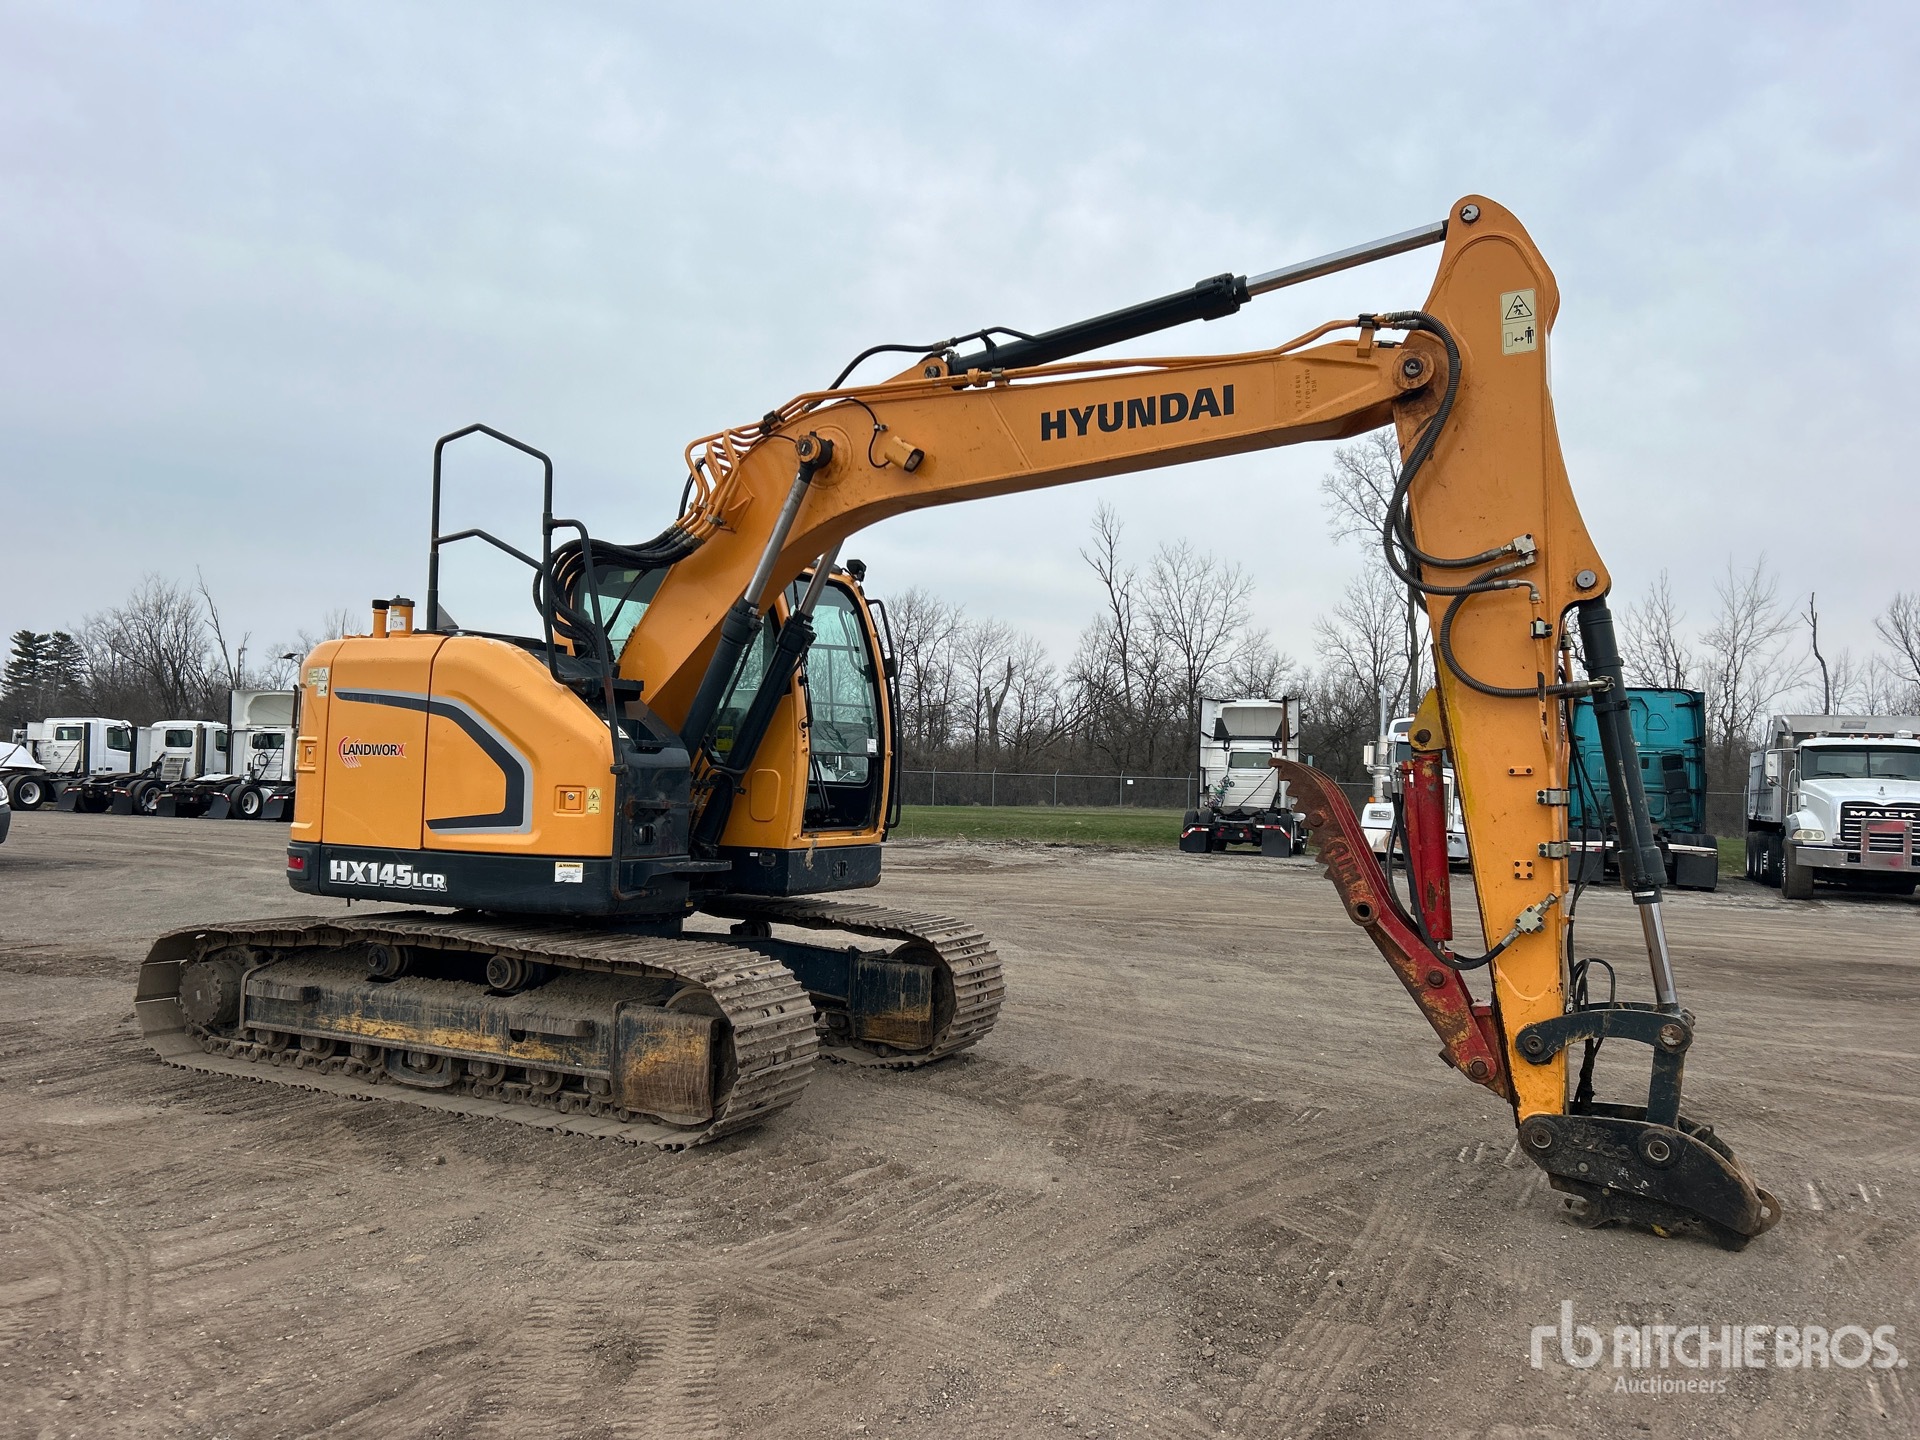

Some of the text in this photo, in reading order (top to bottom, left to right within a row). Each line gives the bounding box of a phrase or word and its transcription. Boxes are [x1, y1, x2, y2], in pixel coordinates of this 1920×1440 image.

[1041, 384, 1235, 442] HYUNDAI
[342, 743, 407, 758] LANDWORX
[1850, 810, 1917, 818] MACK
[329, 859, 448, 892] HX145LCR
